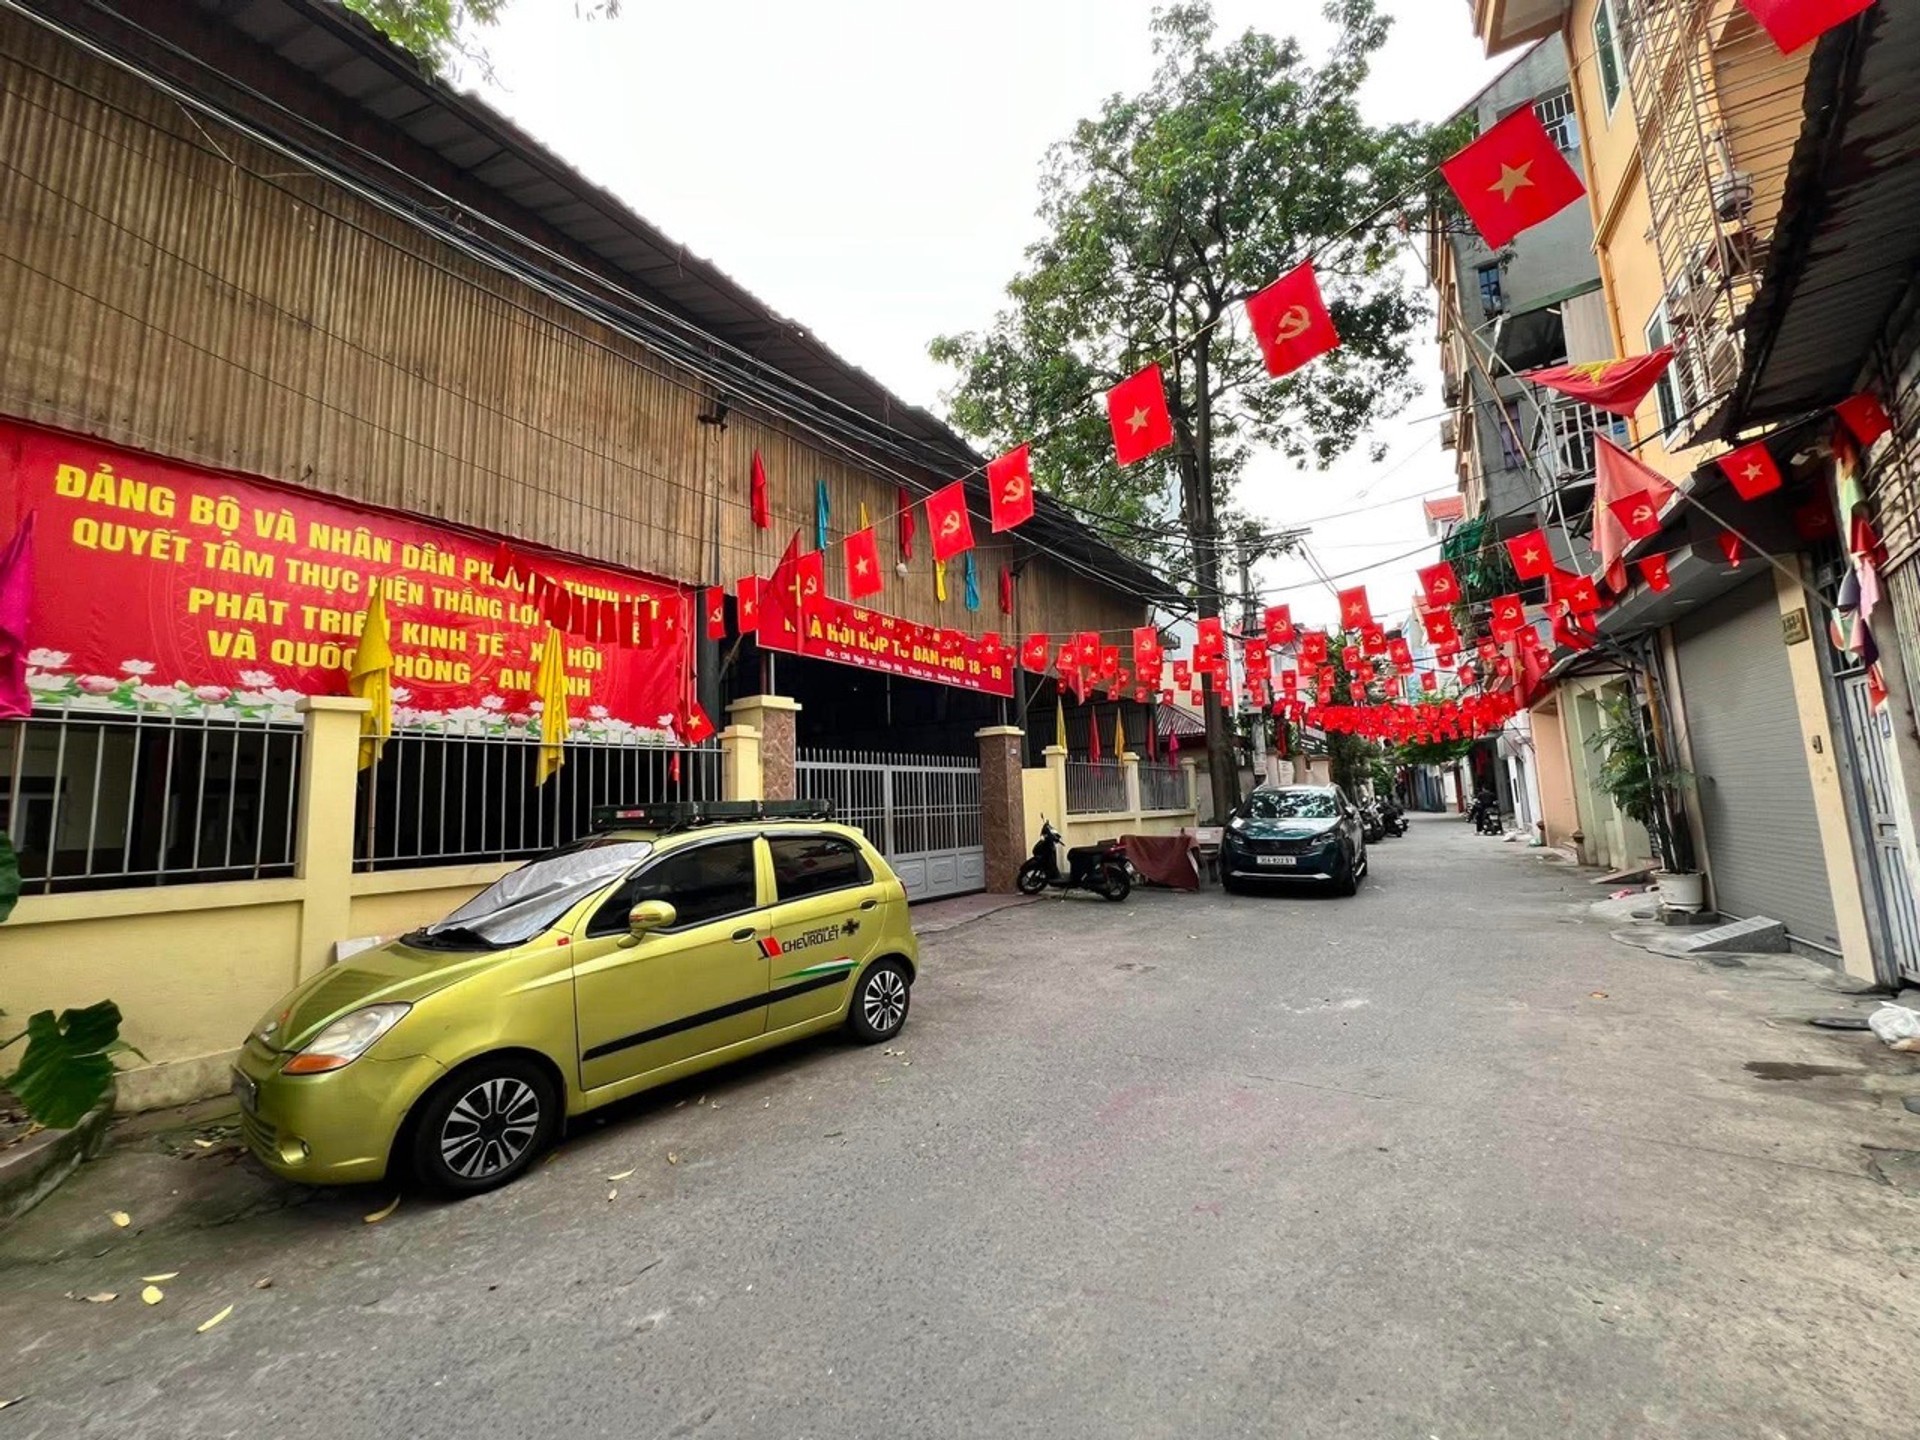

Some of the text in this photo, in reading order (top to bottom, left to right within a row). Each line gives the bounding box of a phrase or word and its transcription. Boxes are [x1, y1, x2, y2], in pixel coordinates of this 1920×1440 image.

[55, 463, 176, 519] ĐẢNG
[190, 494, 240, 537] BỘ
[254, 507, 297, 544] VÀ
[308, 521, 392, 564] NHÂN
[400, 542, 455, 577] DÂN
[72, 517, 191, 563] QUYẾT
[203, 540, 275, 579] TÂM
[284, 558, 360, 595] THỰC
[432, 587, 503, 621] THẮNG
[509, 602, 540, 630] LỢI
[188, 587, 289, 626] PHÁT
[402, 621, 467, 651] KINH
[476, 632, 508, 657] TẾ
[567, 645, 602, 673] HỘI
[208, 629, 257, 661] VÀ
[394, 652, 471, 684] HÒNG
[499, 668, 532, 691] AN
[968, 659, 981, 675] 18
[990, 665, 1002, 680] 19
[781, 929, 840, 953] CHEVROLET
